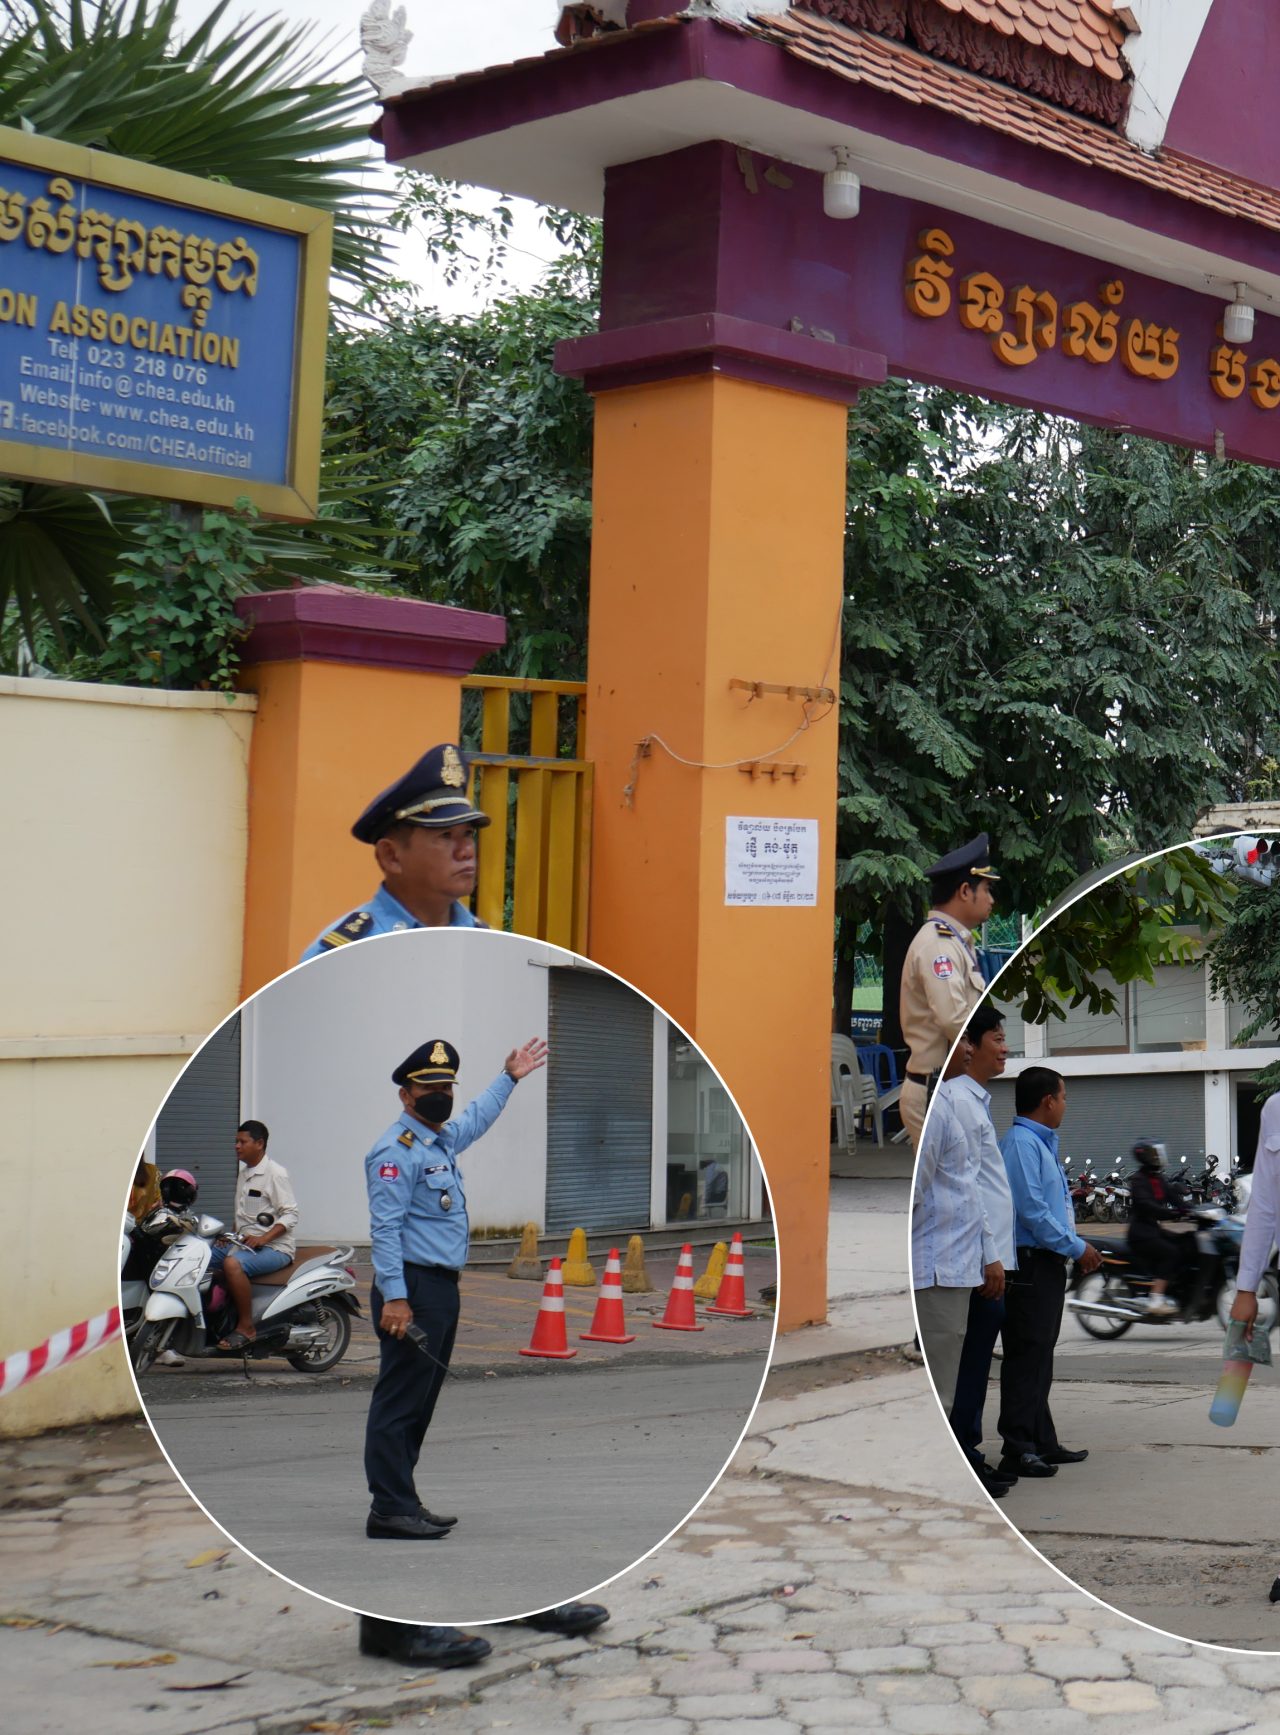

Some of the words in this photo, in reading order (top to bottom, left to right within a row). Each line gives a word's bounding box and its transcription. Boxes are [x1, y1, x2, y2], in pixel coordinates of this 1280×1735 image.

[904, 228, 1181, 381] វិទ្យាល័យ
[49, 301, 240, 369] ASSOCIATION
[87, 345, 126, 370] 023
[133, 355, 167, 378] 218
[172, 363, 208, 386] 076
[98, 400, 256, 442] www.chea.edu.kh
